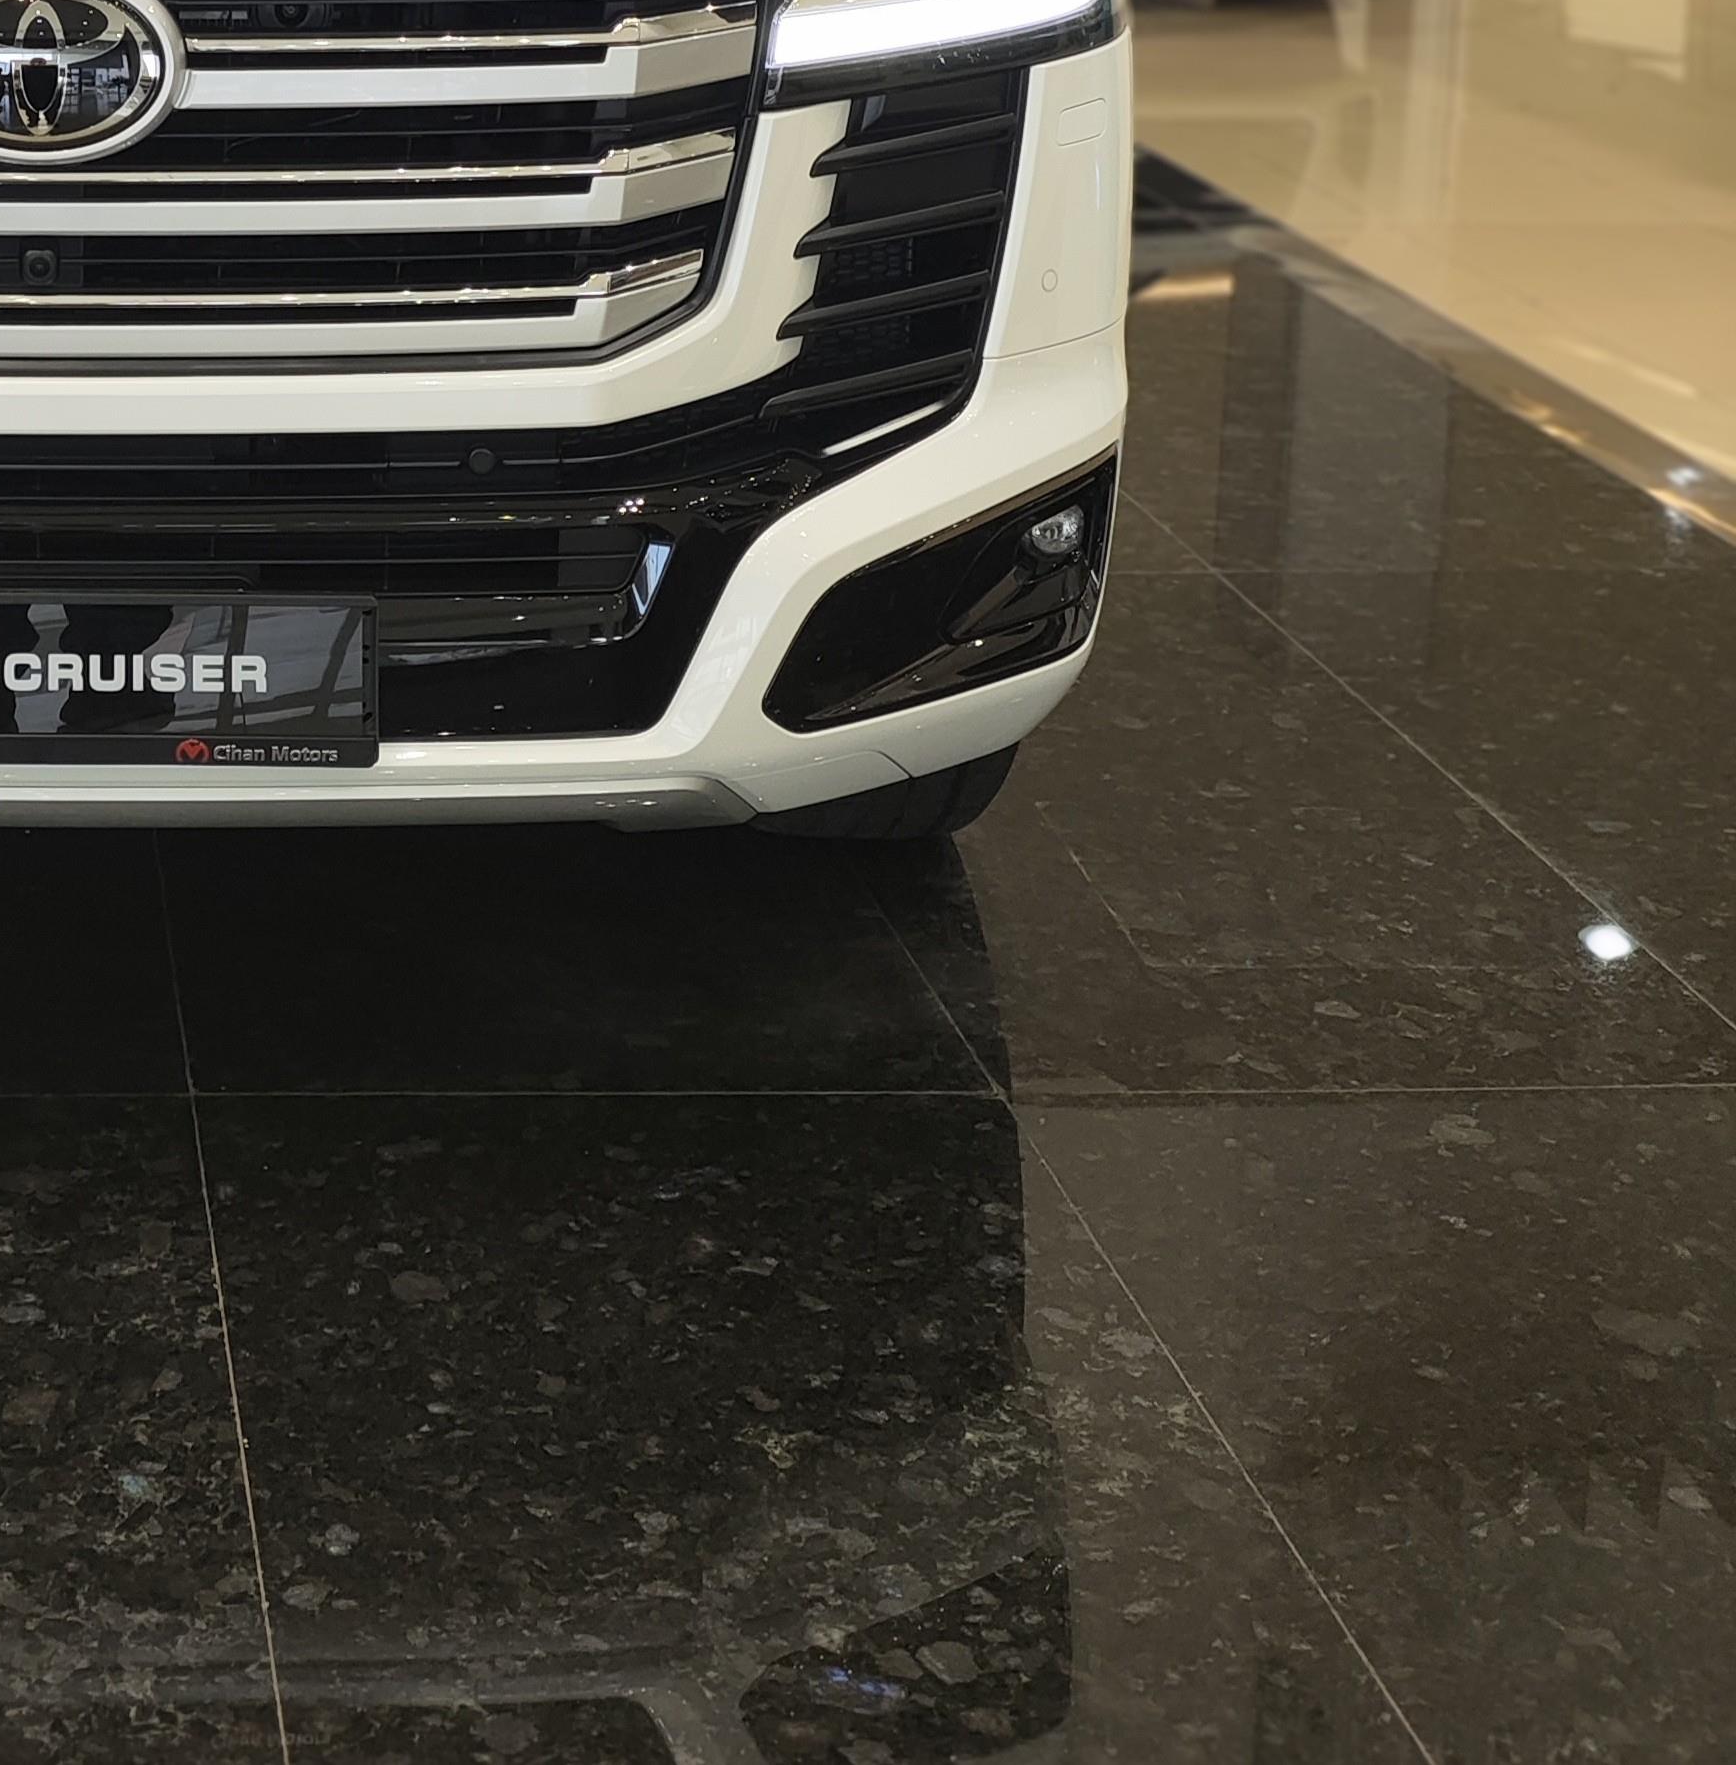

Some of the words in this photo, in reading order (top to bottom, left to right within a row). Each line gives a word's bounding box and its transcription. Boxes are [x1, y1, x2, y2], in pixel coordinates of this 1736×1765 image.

[3, 653, 267, 693] CRUISER
[213, 744, 265, 762] Cihan
[271, 745, 338, 763] Motors
